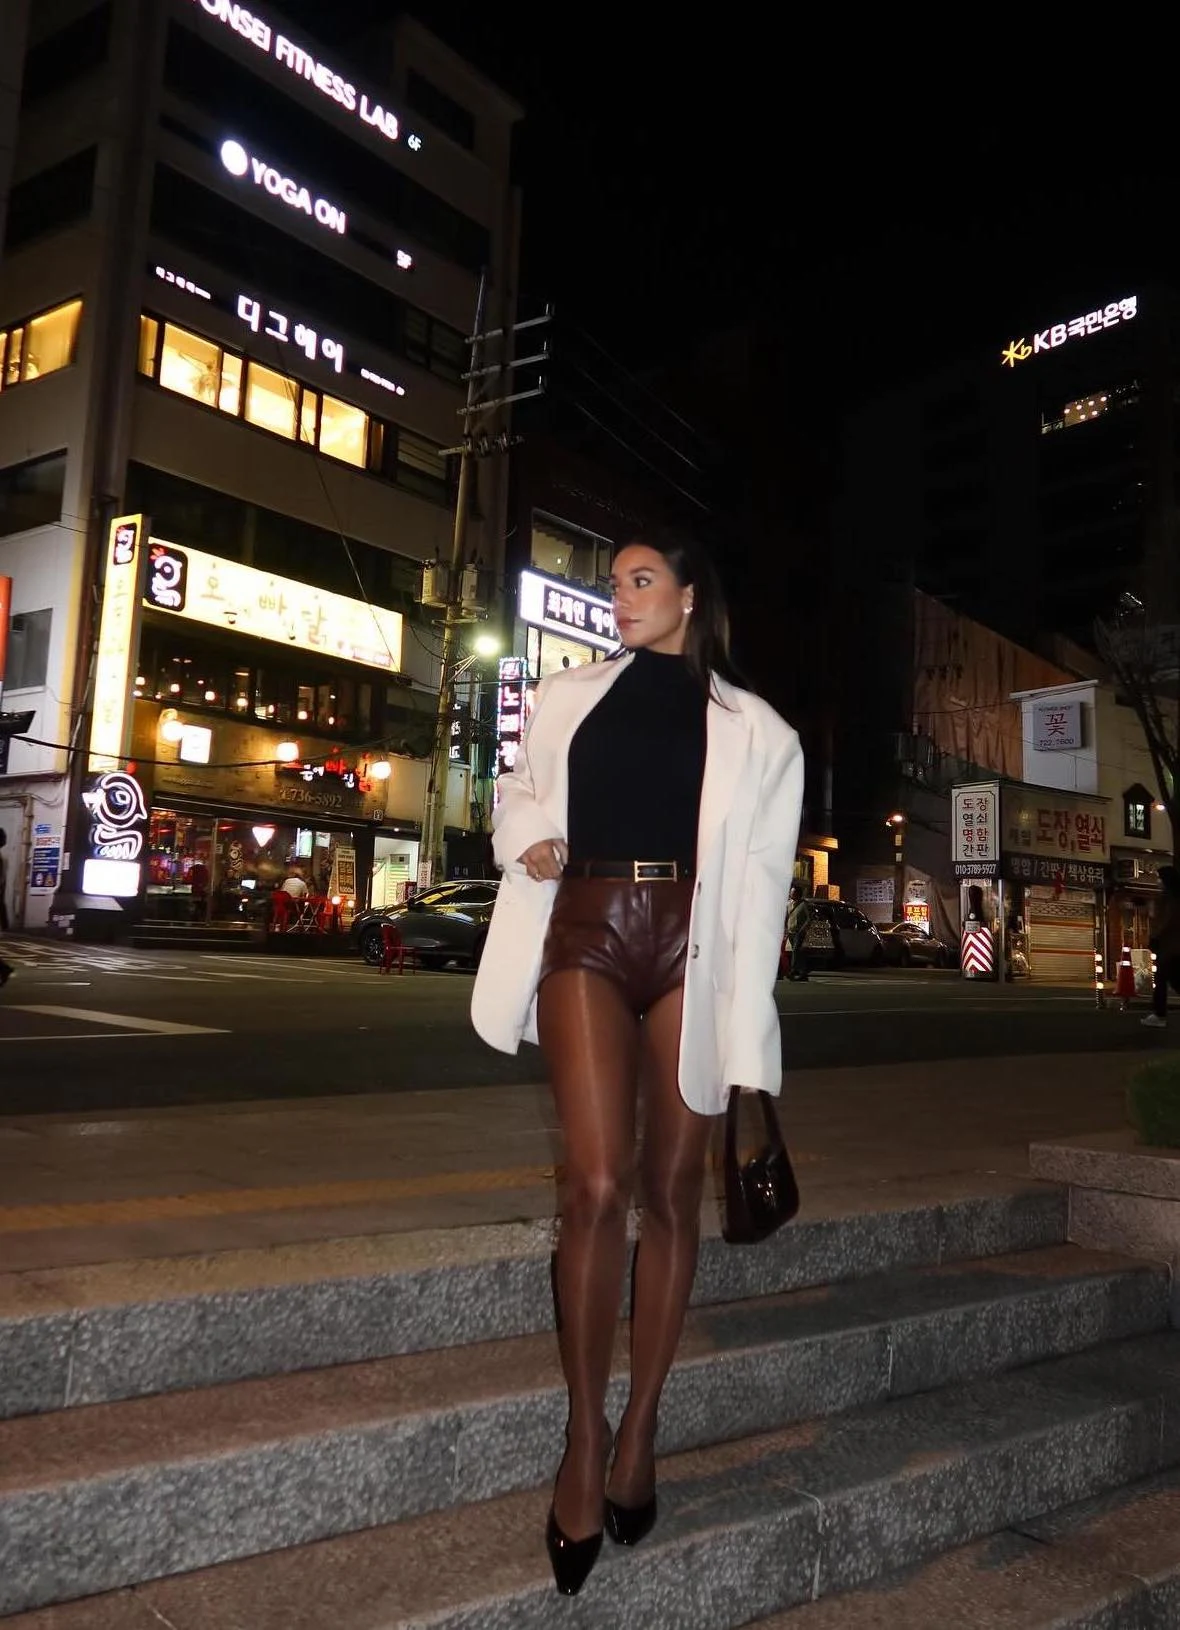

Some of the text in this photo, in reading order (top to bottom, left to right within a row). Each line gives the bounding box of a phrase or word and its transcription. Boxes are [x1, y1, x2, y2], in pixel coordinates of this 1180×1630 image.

[194, 0, 271, 51] ONSEI
[275, 34, 356, 111] FITNESS
[360, 95, 398, 140] LAB
[251, 157, 312, 215] YOGA
[315, 198, 346, 234] ON
[962, 797, 989, 812] 도장
[962, 813, 988, 827] 열쇠
[962, 828, 989, 842] 명함
[962, 844, 989, 858] 간판
